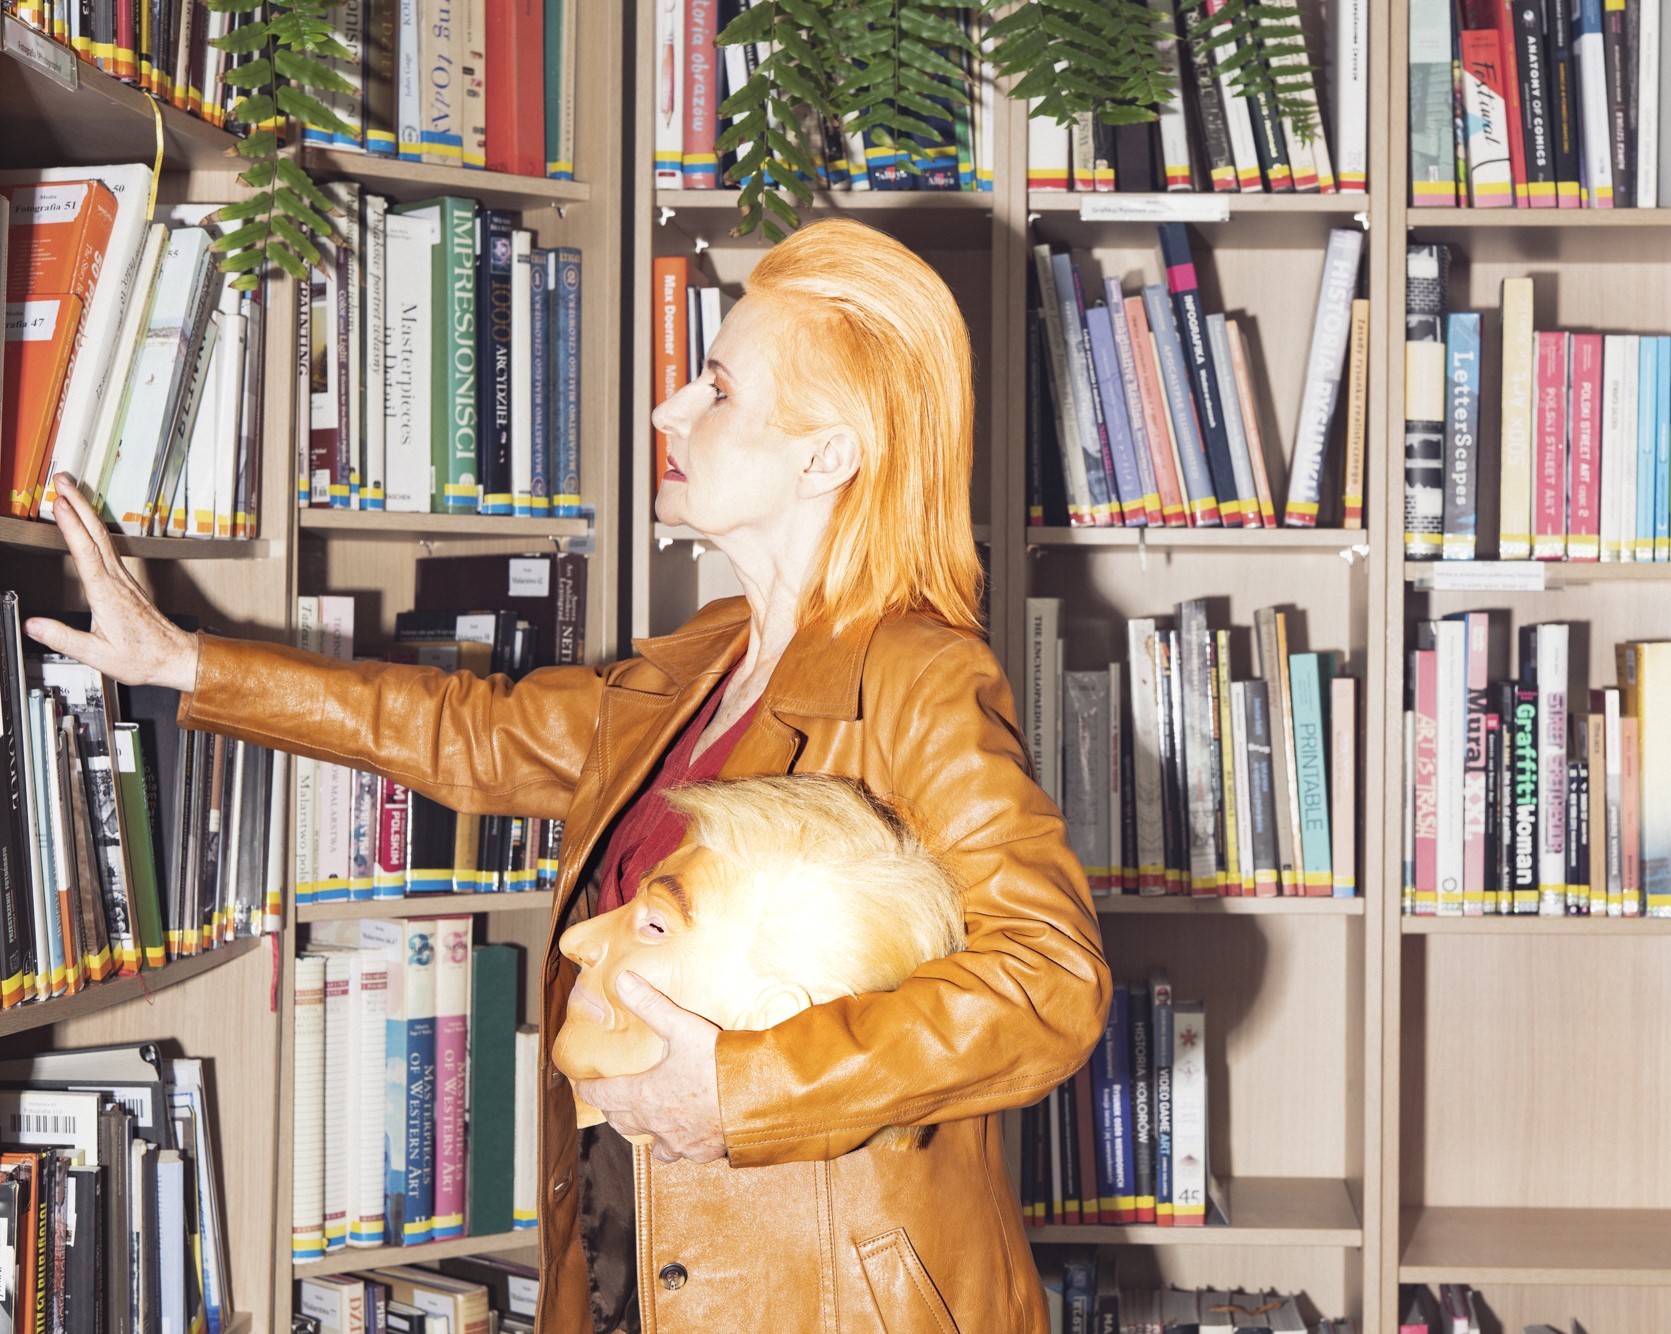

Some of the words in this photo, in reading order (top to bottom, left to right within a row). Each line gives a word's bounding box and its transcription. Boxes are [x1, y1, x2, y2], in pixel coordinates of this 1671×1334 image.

[692, 54, 710, 132] obrazów
[1525, 36, 1541, 97] ANATOMY
[1472, 60, 1500, 145] Festival
[1531, 100, 1542, 115] OF
[1532, 117, 1547, 166] COMICS
[15, 203, 61, 214] Fotografia
[64, 201, 77, 211] 51
[91, 250, 103, 280] 50
[664, 275, 676, 302] Max
[31, 318, 45, 328] 47
[299, 281, 309, 376] PAINTING
[491, 281, 512, 343] 1000
[664, 304, 677, 355] Doerner
[1183, 294, 1205, 364] INFOGRAFIKA
[1315, 259, 1353, 371] HISTORIA
[1356, 318, 1365, 354] Zasady
[400, 303, 417, 446] Masterpieces
[1355, 359, 1364, 401] rysunku
[1581, 381, 1591, 418] POLSKI
[1452, 351, 1475, 506] LetterScapes
[1544, 387, 1556, 432] POLSKI
[568, 405, 576, 470] MALARSTWO
[1296, 380, 1334, 498] RYSUNKU
[1351, 405, 1363, 485] realistycznego
[1544, 436, 1555, 484] STREET
[1579, 421, 1590, 459] STREET
[1579, 463, 1590, 482] ART
[1544, 489, 1555, 515] ART
[1033, 615, 1042, 638] THE
[1033, 641, 1042, 730] ENCYCLOPAEDIA
[1033, 733, 1042, 747] OF
[1415, 713, 1436, 750] ART
[1466, 687, 1488, 773] Mural
[1516, 703, 1538, 805] Graffiti
[1299, 722, 1324, 832] PRINTABLE
[300, 775, 310, 849] Malarstwo
[330, 785, 339, 853] MALARSTWA
[390, 810, 401, 864] POLSKIM
[3, 846, 12, 891] FOTOGRAFII
[1516, 804, 1536, 885] Woman
[6, 891, 15, 944] PRZESTRZENIE
[409, 1052, 421, 1074] OF
[443, 1049, 455, 1071] OF
[1135, 1022, 1146, 1076] HISTORIA
[1160, 1069, 1170, 1100] VIDEO
[408, 1080, 424, 1160] WESTERN
[422, 1064, 436, 1185] MASTERPIECES
[442, 1078, 457, 1158] WESTERN
[455, 1061, 467, 1182] MASTERPIECES
[1136, 1082, 1150, 1144] KOLORÓW
[1160, 1102, 1170, 1132] GAME
[1160, 1134, 1169, 1155] ART
[408, 1165, 423, 1199] ART
[441, 1164, 456, 1195] ART
